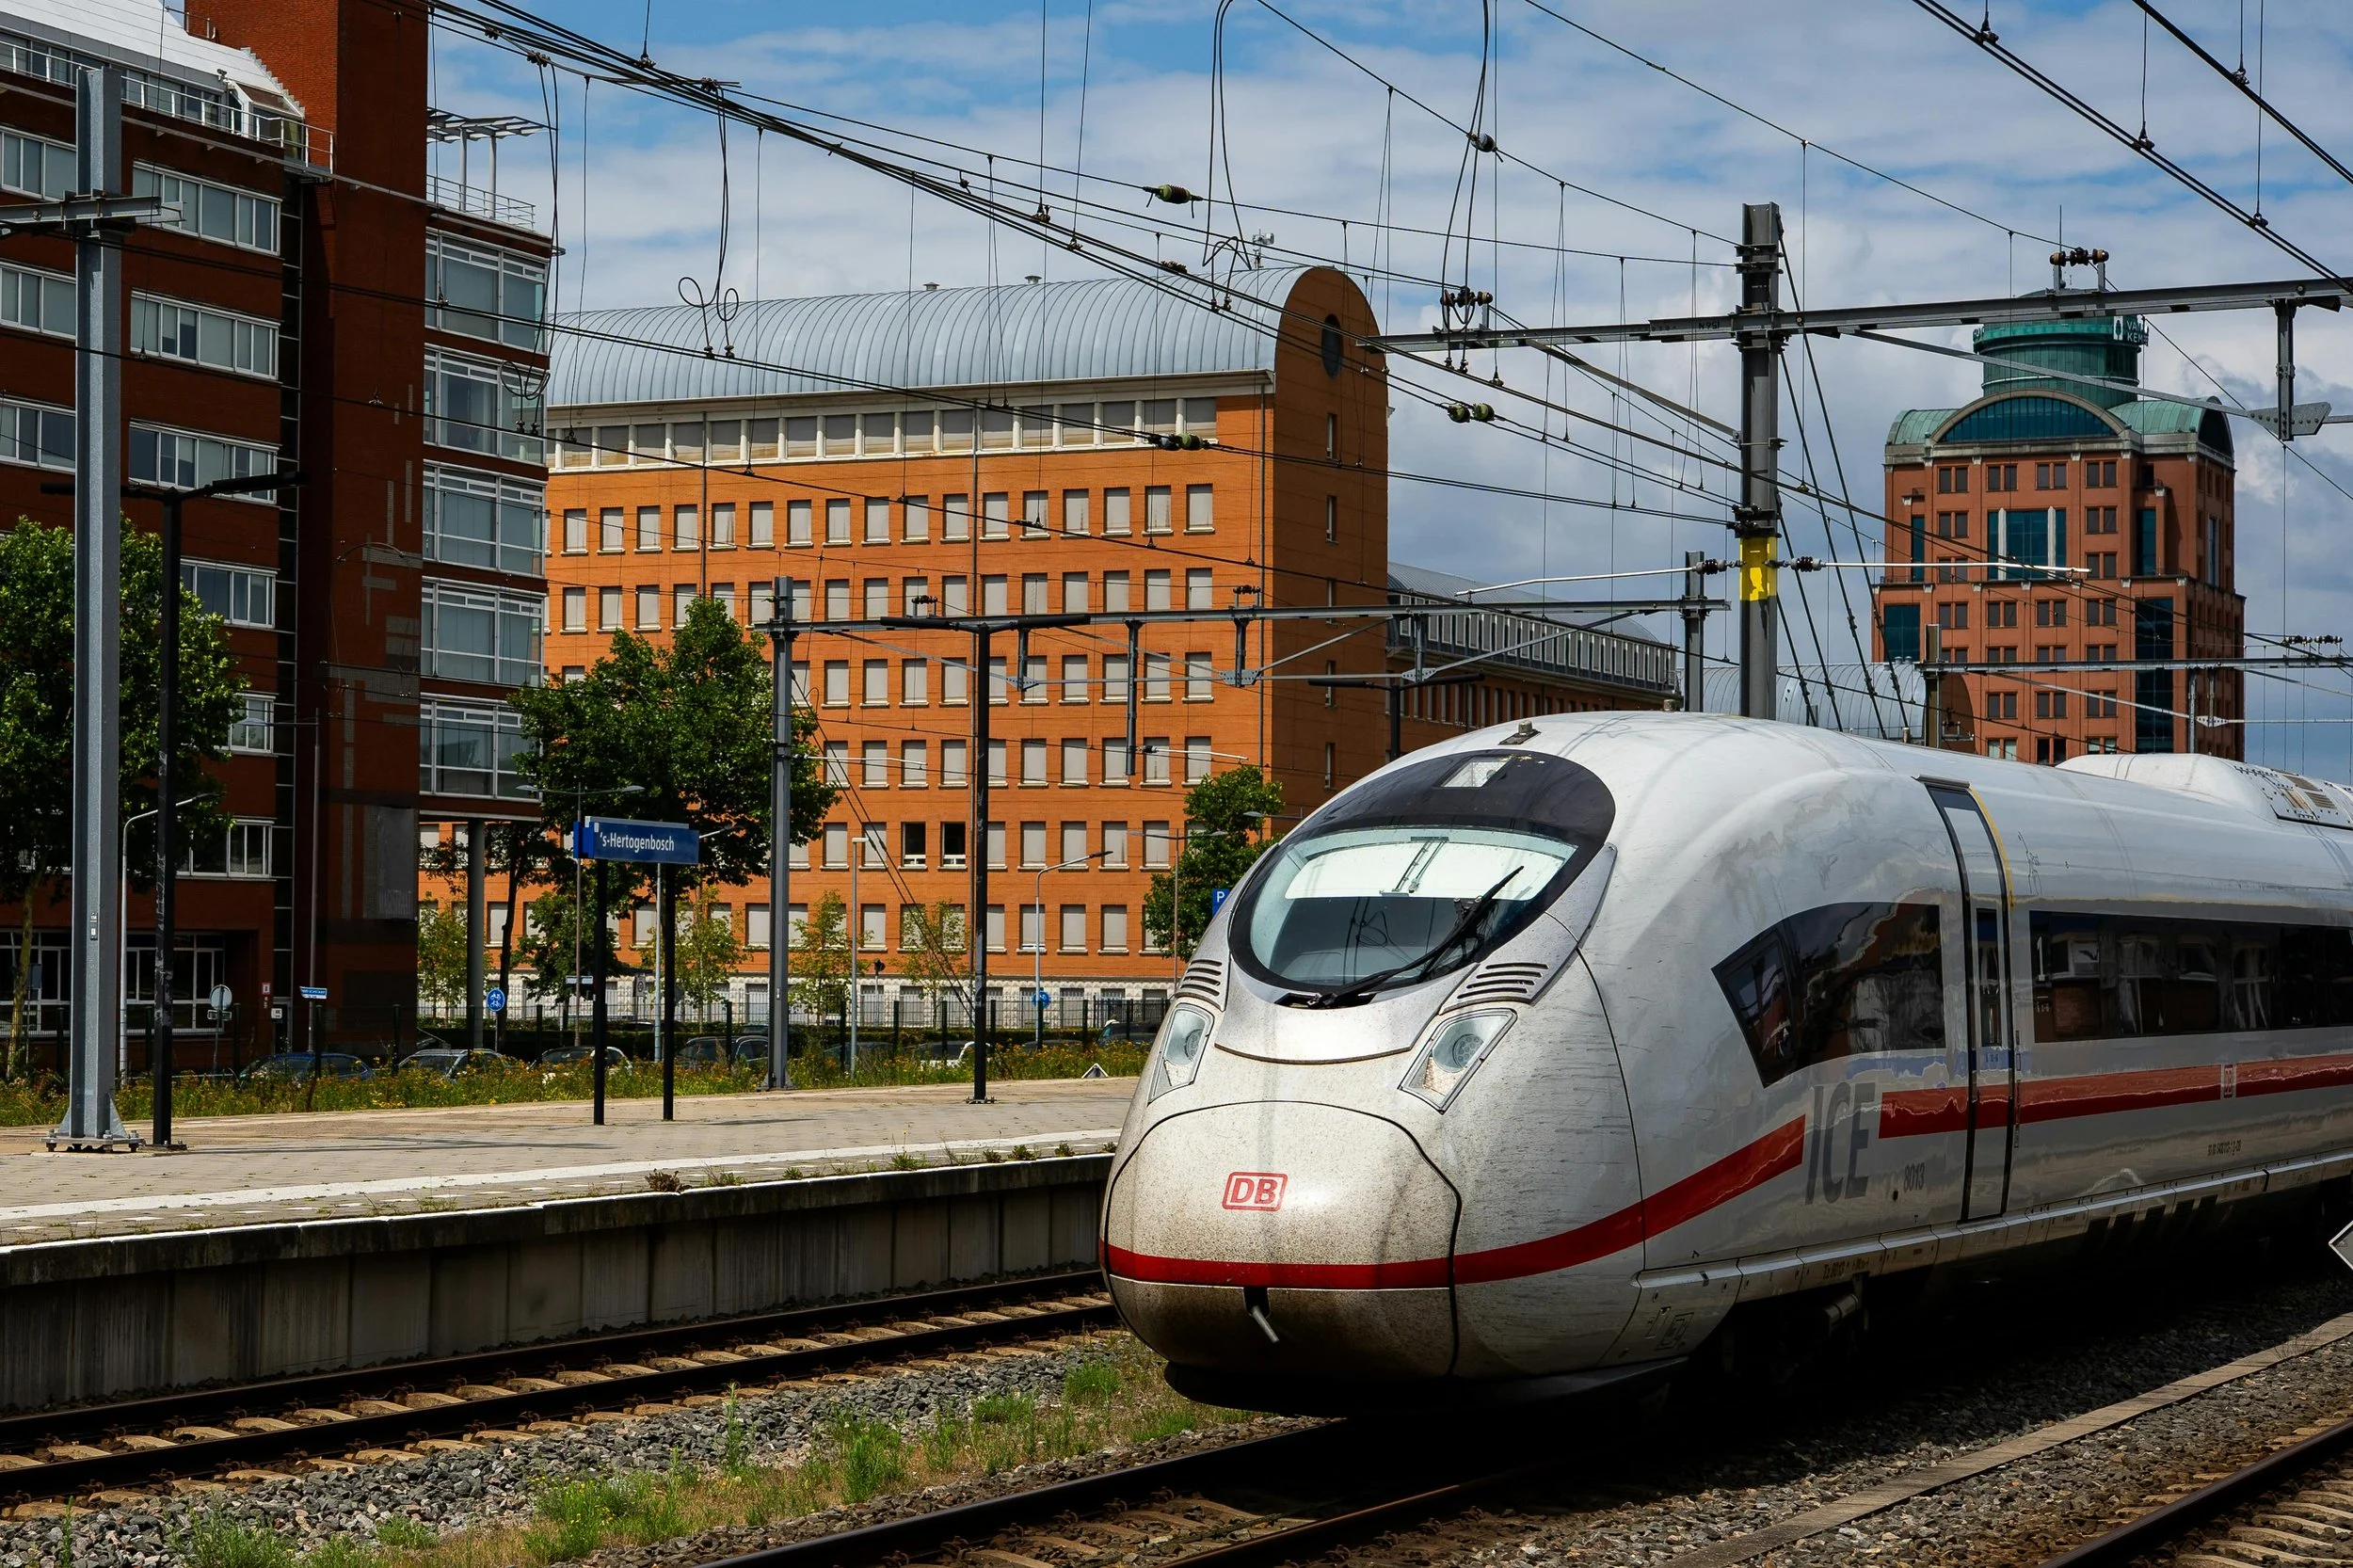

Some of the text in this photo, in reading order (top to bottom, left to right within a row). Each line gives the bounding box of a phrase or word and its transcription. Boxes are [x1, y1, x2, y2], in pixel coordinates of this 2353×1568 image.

[600, 831, 675, 853] 's-Hertogenbosch
[1216, 890, 1225, 904] P
[1804, 1081, 1876, 1206] ICE
[1230, 1177, 1278, 1205] DB
[1903, 1161, 1926, 1193] 8013
